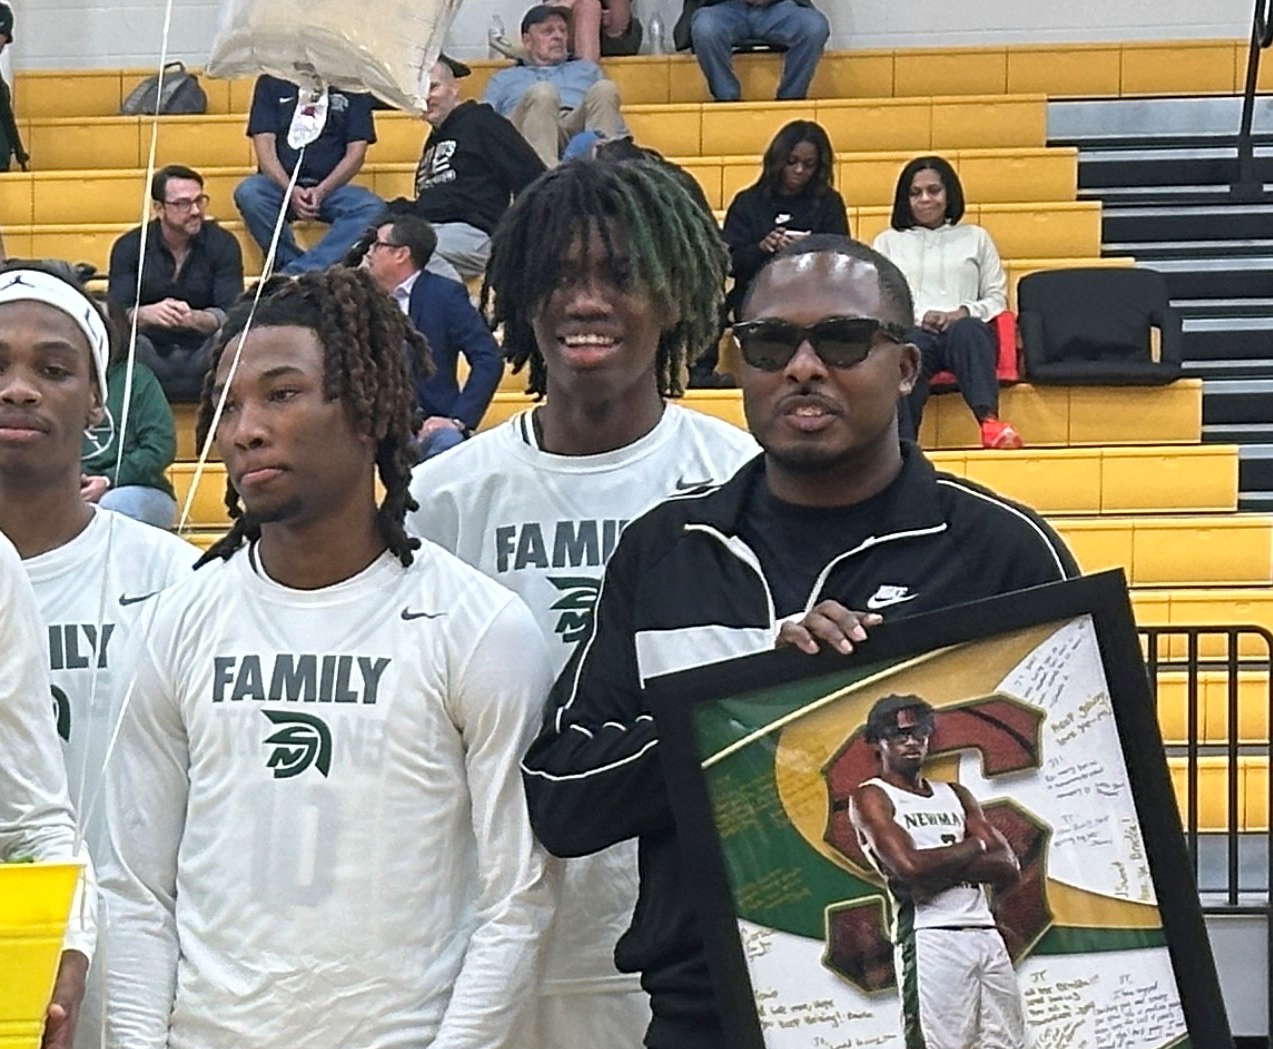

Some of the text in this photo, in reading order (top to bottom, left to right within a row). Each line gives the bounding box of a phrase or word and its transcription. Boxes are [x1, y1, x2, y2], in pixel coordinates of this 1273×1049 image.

[496, 519, 630, 573] FAMI
[48, 623, 115, 670] ILY
[212, 654, 392, 704] FAMILY
[903, 811, 964, 829] NEWMA
